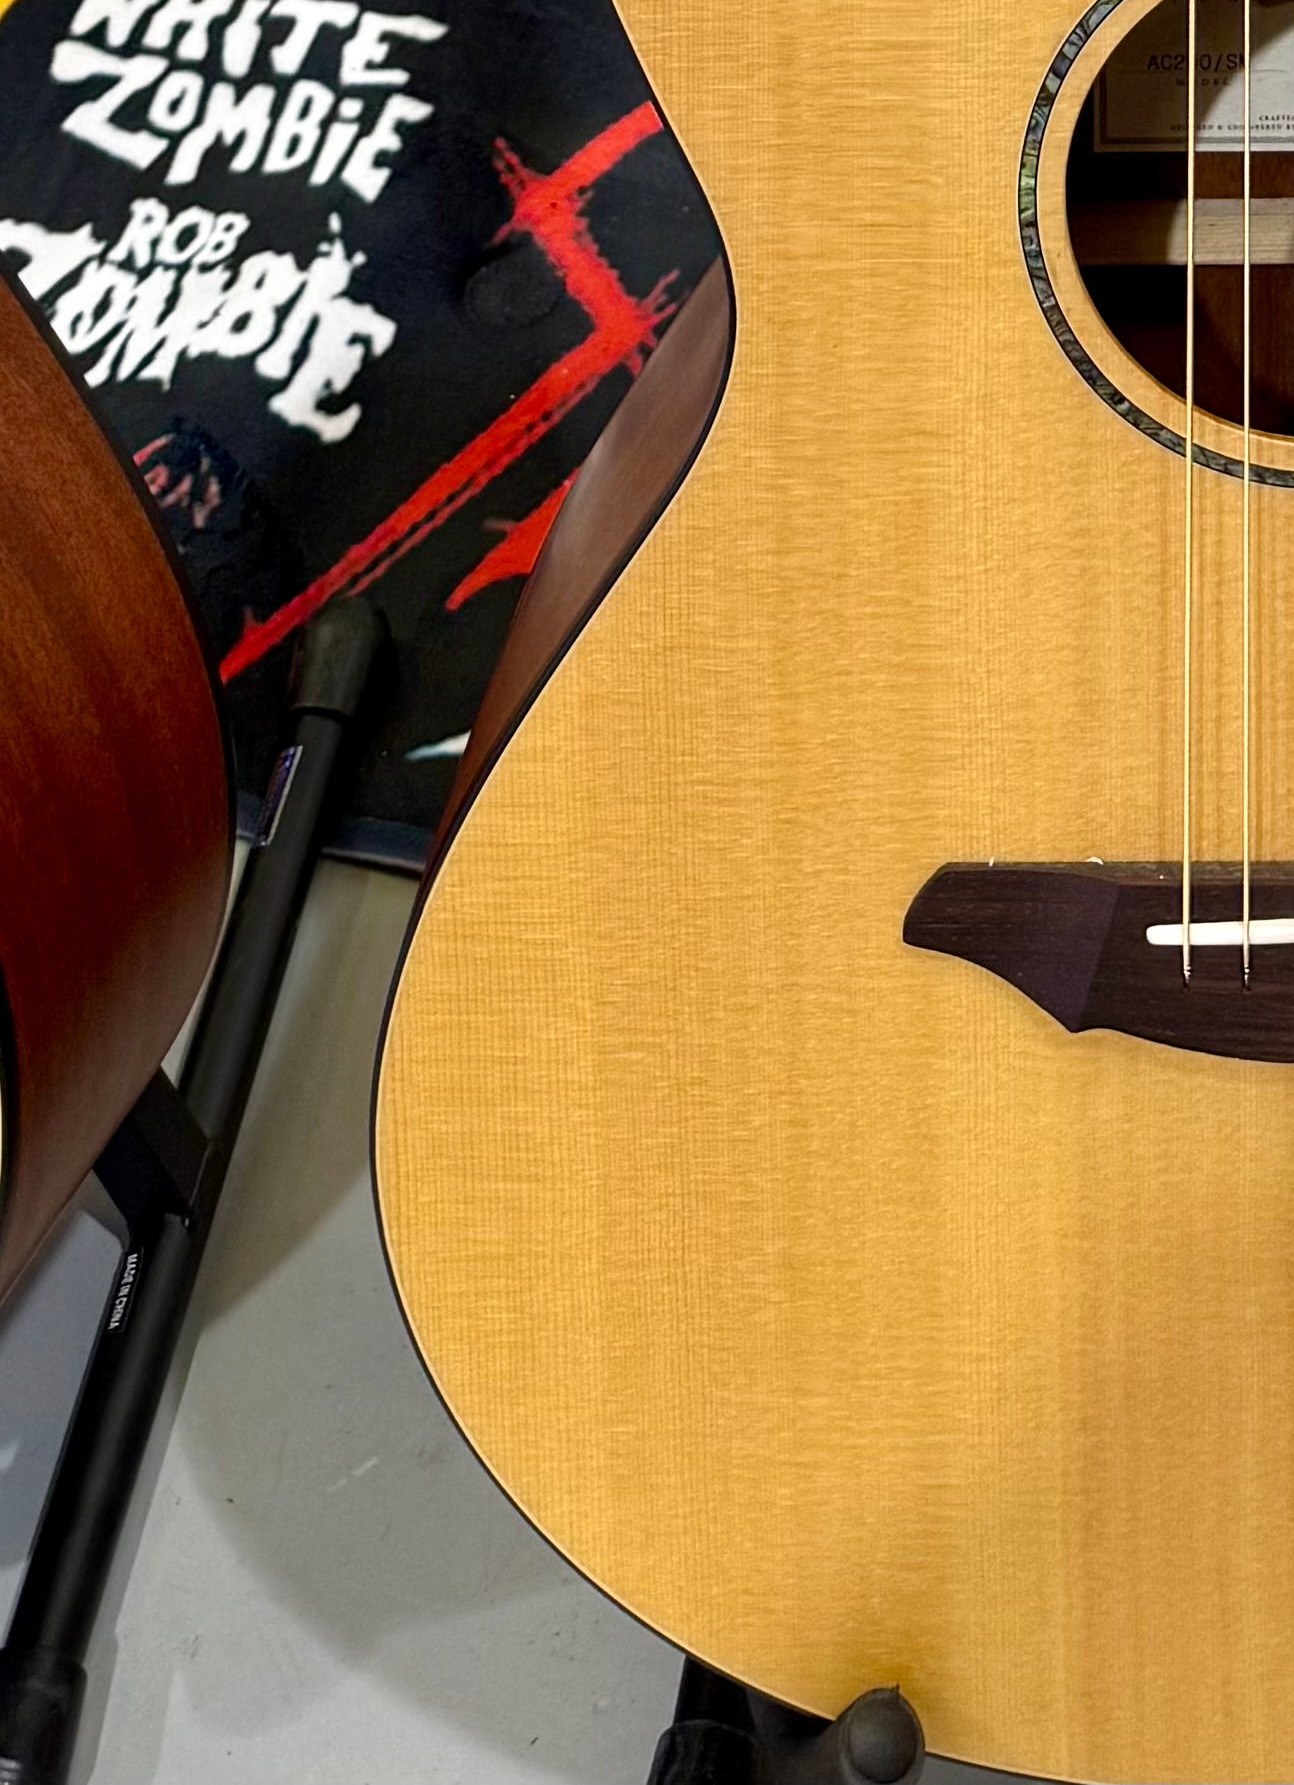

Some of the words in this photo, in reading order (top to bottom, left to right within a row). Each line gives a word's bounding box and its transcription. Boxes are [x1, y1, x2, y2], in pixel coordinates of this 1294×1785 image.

[1146, 53, 1250, 71] AC20/S
[1175, 77, 1229, 87] MDEL
[50, 40, 435, 204] ZOMBIE
[108, 197, 251, 269] ROB
